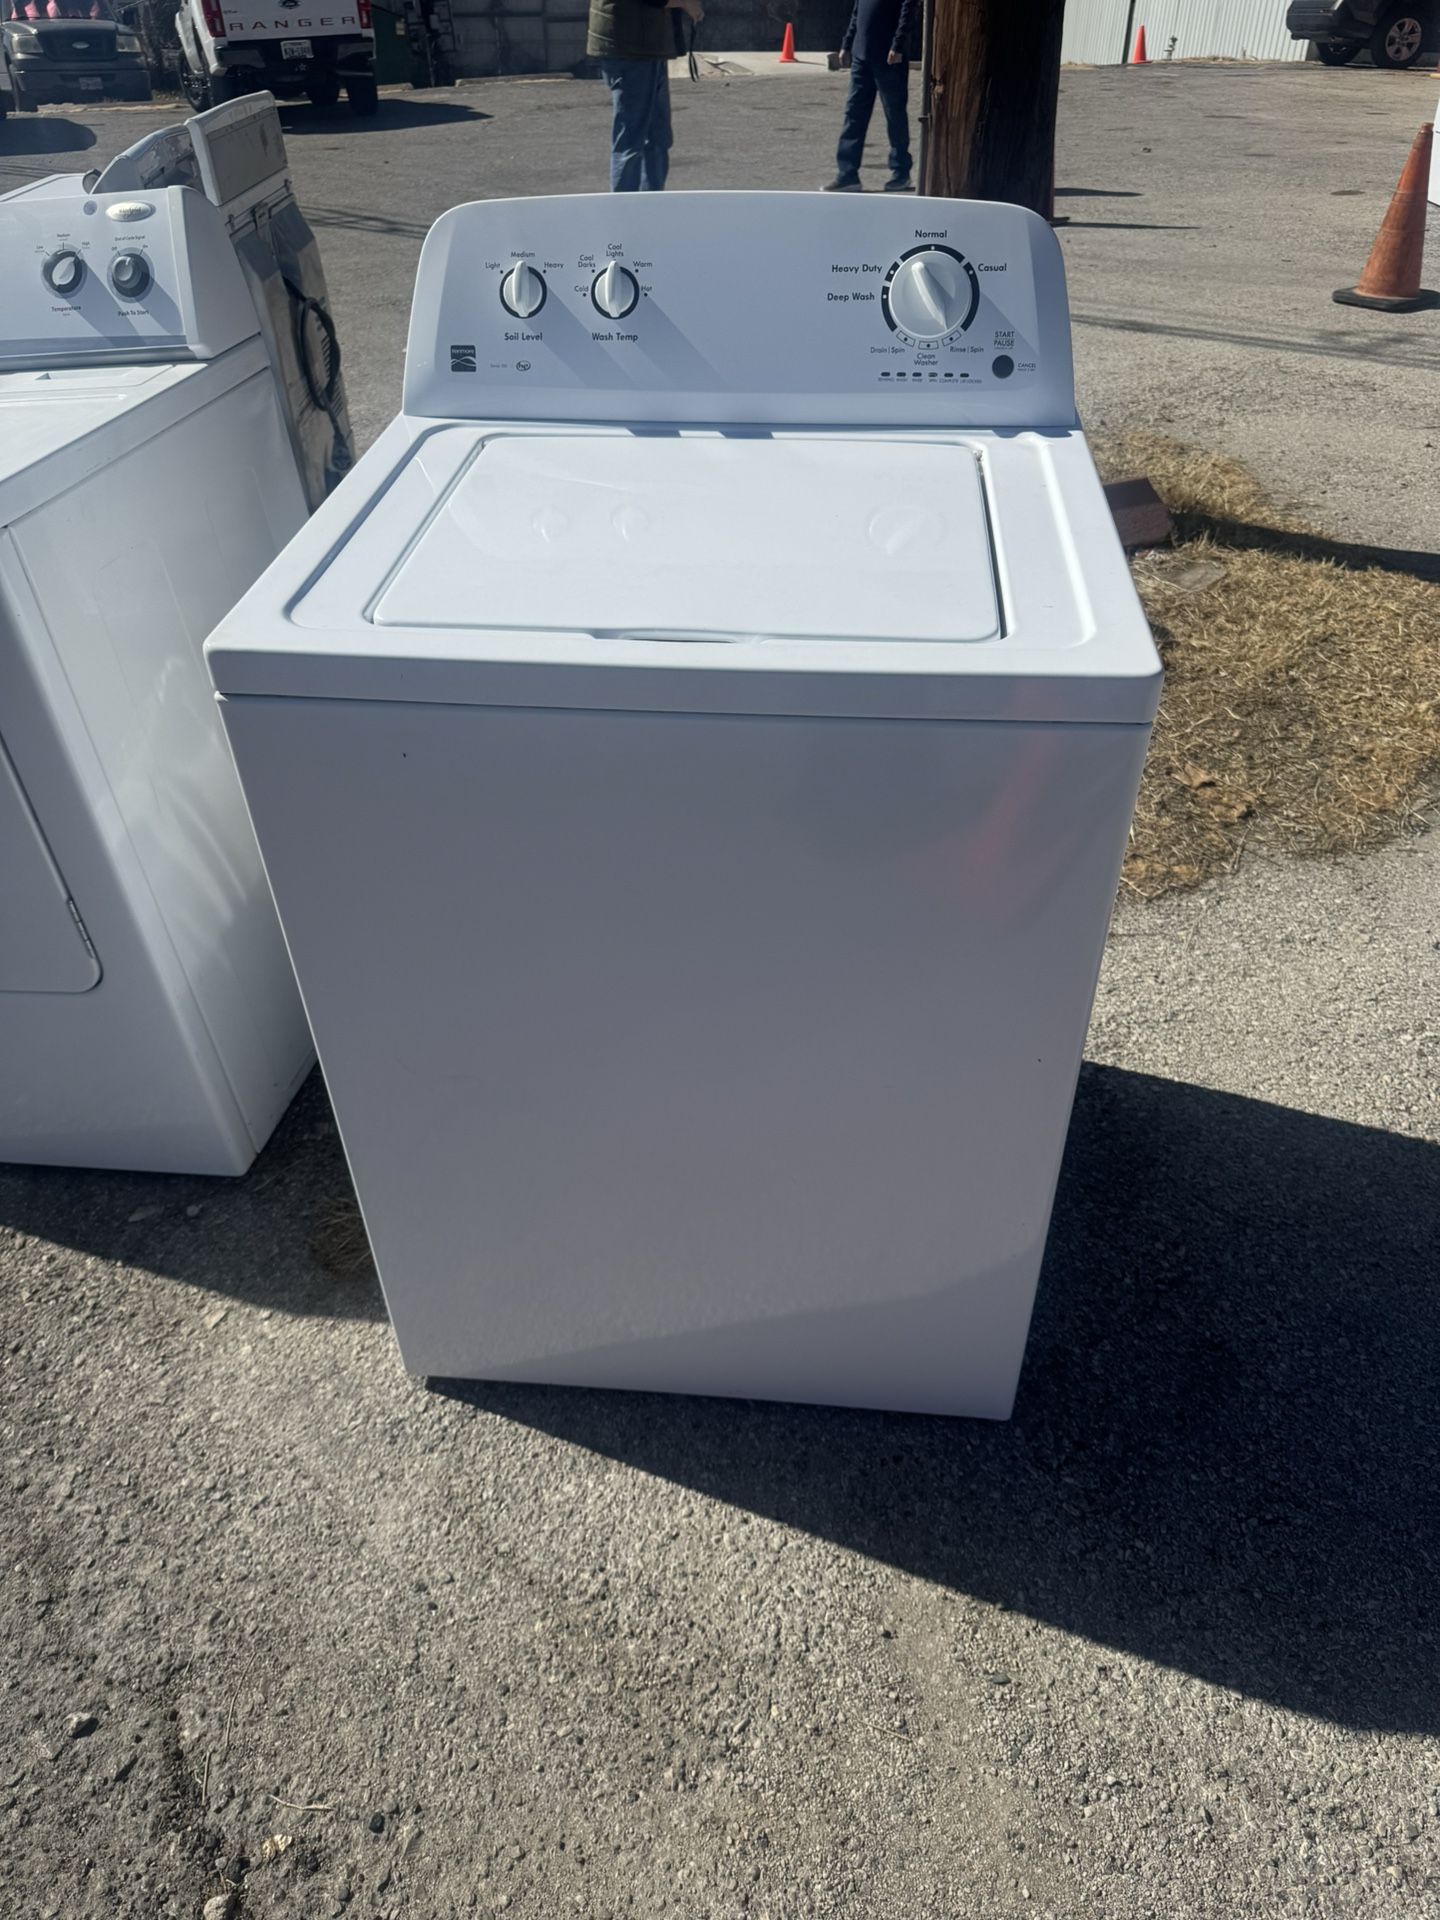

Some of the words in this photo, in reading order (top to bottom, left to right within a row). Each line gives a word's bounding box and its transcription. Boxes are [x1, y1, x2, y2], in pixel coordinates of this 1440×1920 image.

[229, 16, 355, 31] RANGER
[914, 229, 947, 239] Normal
[510, 250, 535, 258] Medium
[485, 262, 501, 270] Light
[543, 261, 564, 270] Heavy
[632, 260, 653, 268] Warm
[977, 263, 1007, 272] Casual
[831, 264, 859, 274] Heavy
[862, 264, 883, 274] Duty
[574, 285, 589, 293] Cold
[827, 292, 850, 303] Deep
[851, 292, 875, 301] Wash
[52, 305, 81, 313] Temperature
[504, 332, 519, 341] Soil
[521, 332, 543, 341] Level
[591, 332, 613, 341] Wash
[616, 332, 639, 343] Temp
[994, 330, 1016, 338] START
[993, 338, 1015, 347] PAUSE
[916, 352, 936, 360] Clean
